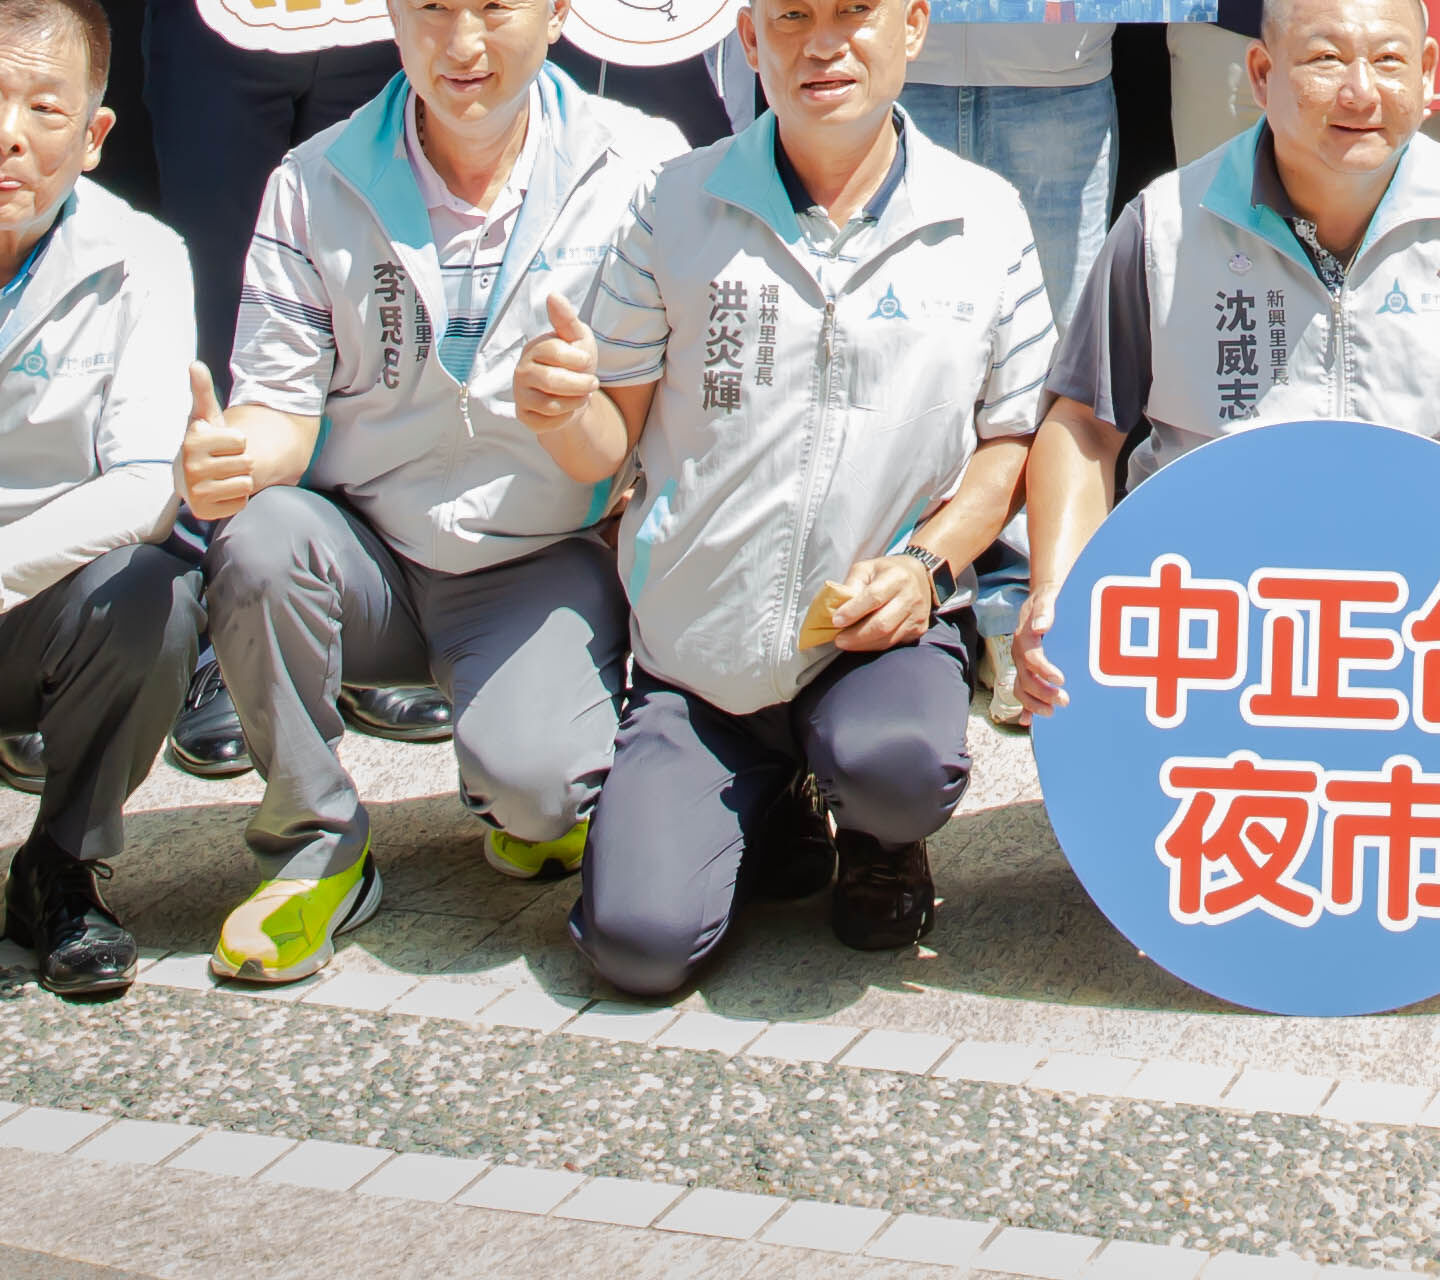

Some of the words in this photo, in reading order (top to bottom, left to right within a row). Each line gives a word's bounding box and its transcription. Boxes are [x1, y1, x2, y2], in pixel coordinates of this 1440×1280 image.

[703, 280, 748, 416] 洪炎輝
[754, 284, 780, 387] 福林里里長
[1215, 289, 1260, 421] 沈威志
[1265, 289, 1289, 387] 新興里里長
